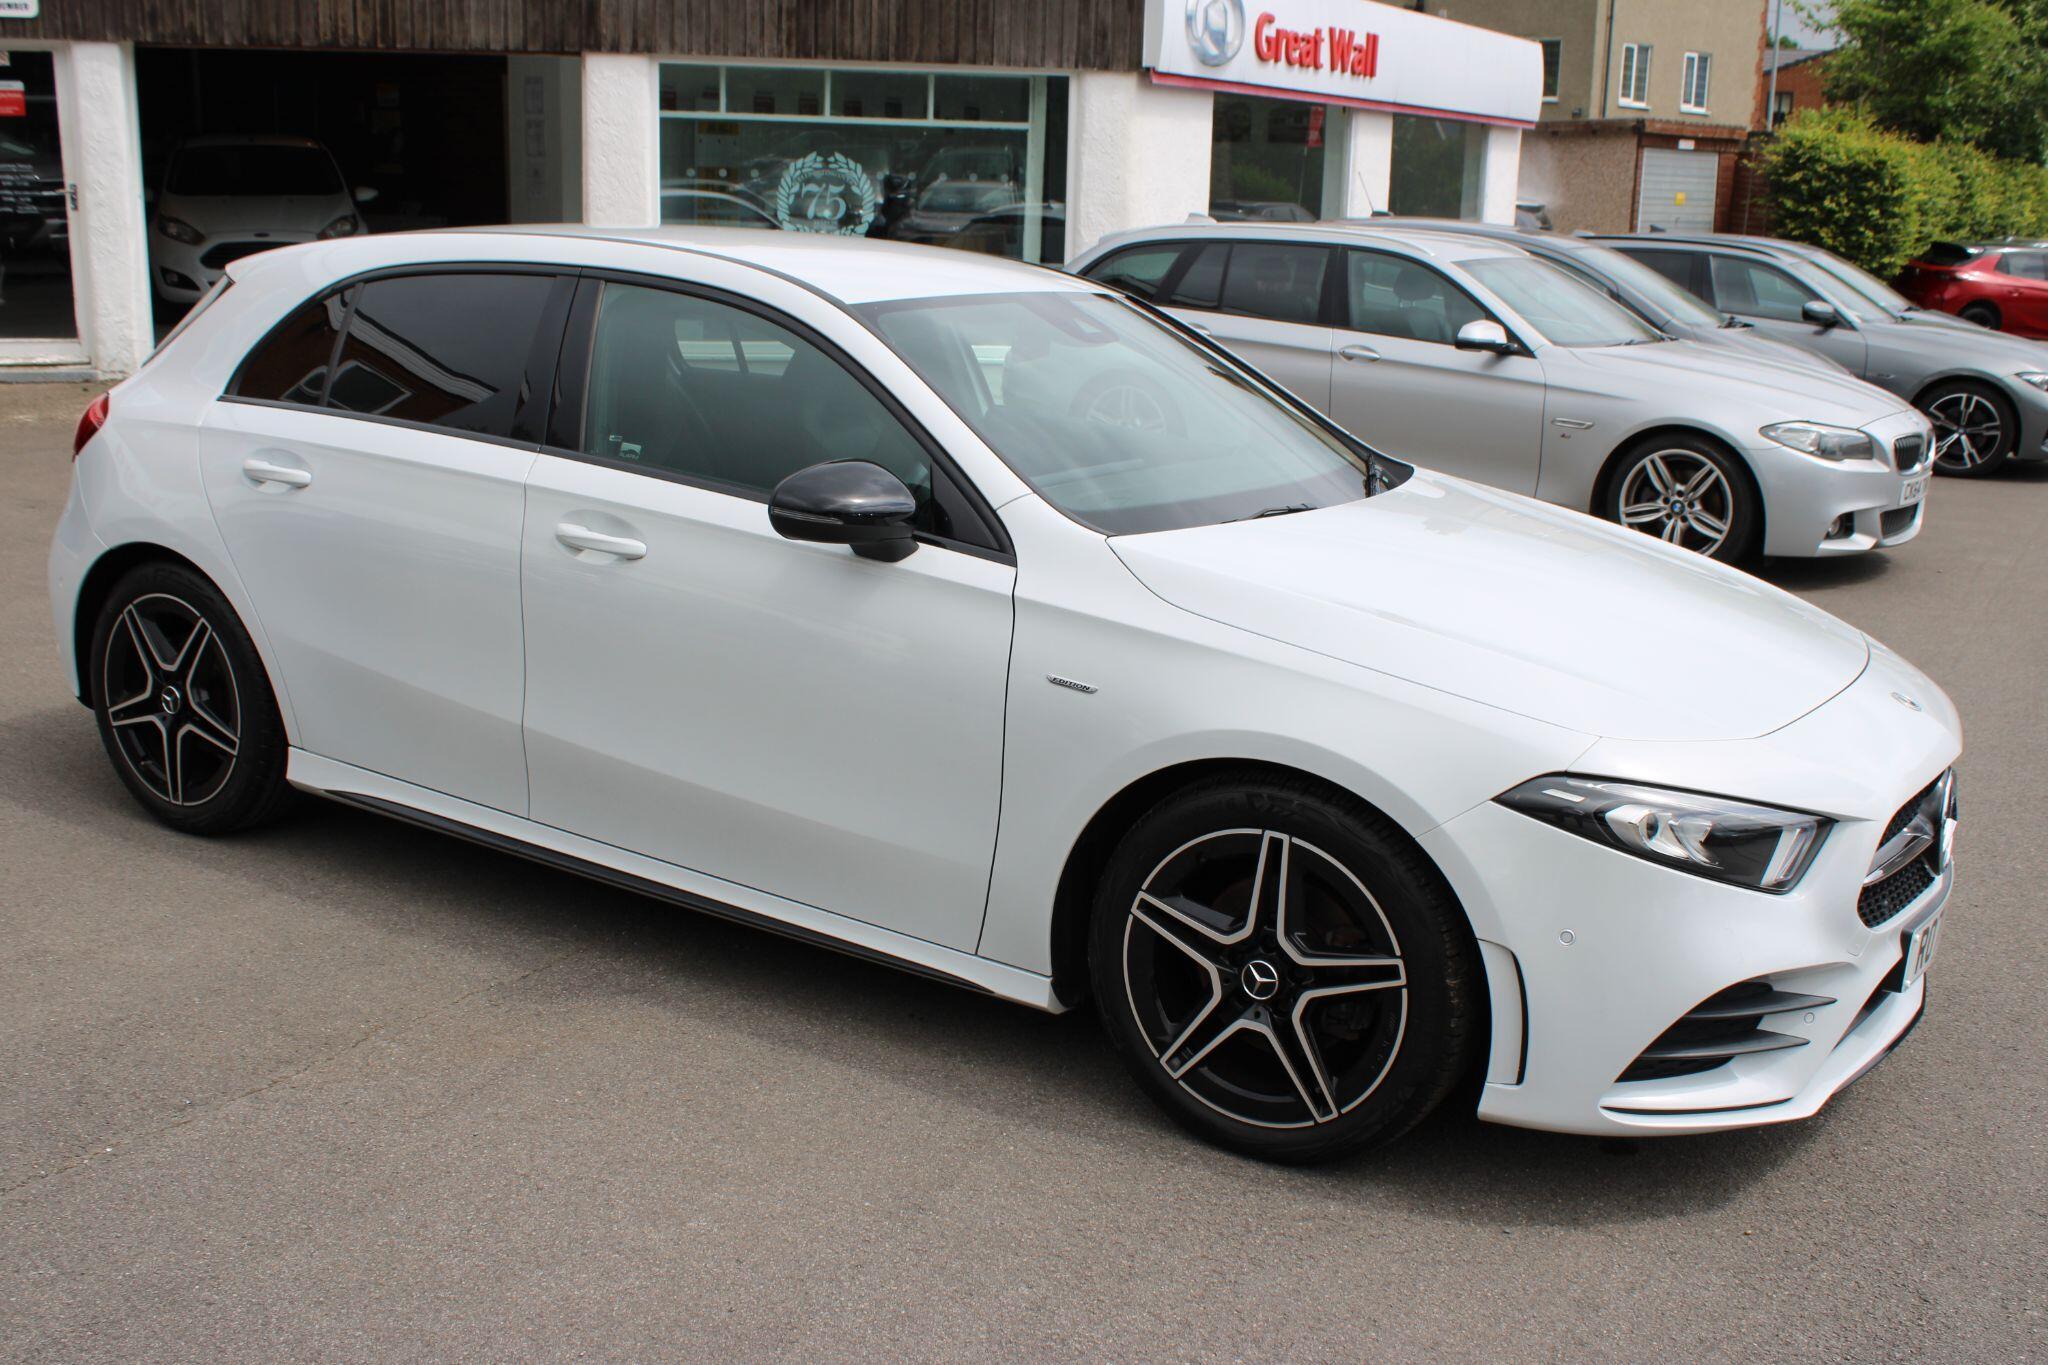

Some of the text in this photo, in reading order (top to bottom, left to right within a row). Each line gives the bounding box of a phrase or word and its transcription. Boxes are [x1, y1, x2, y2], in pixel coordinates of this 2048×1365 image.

[1255, 11, 1379, 78] Great Wall
[801, 183, 846, 220] 75
[1052, 677, 1091, 691] EDITION
